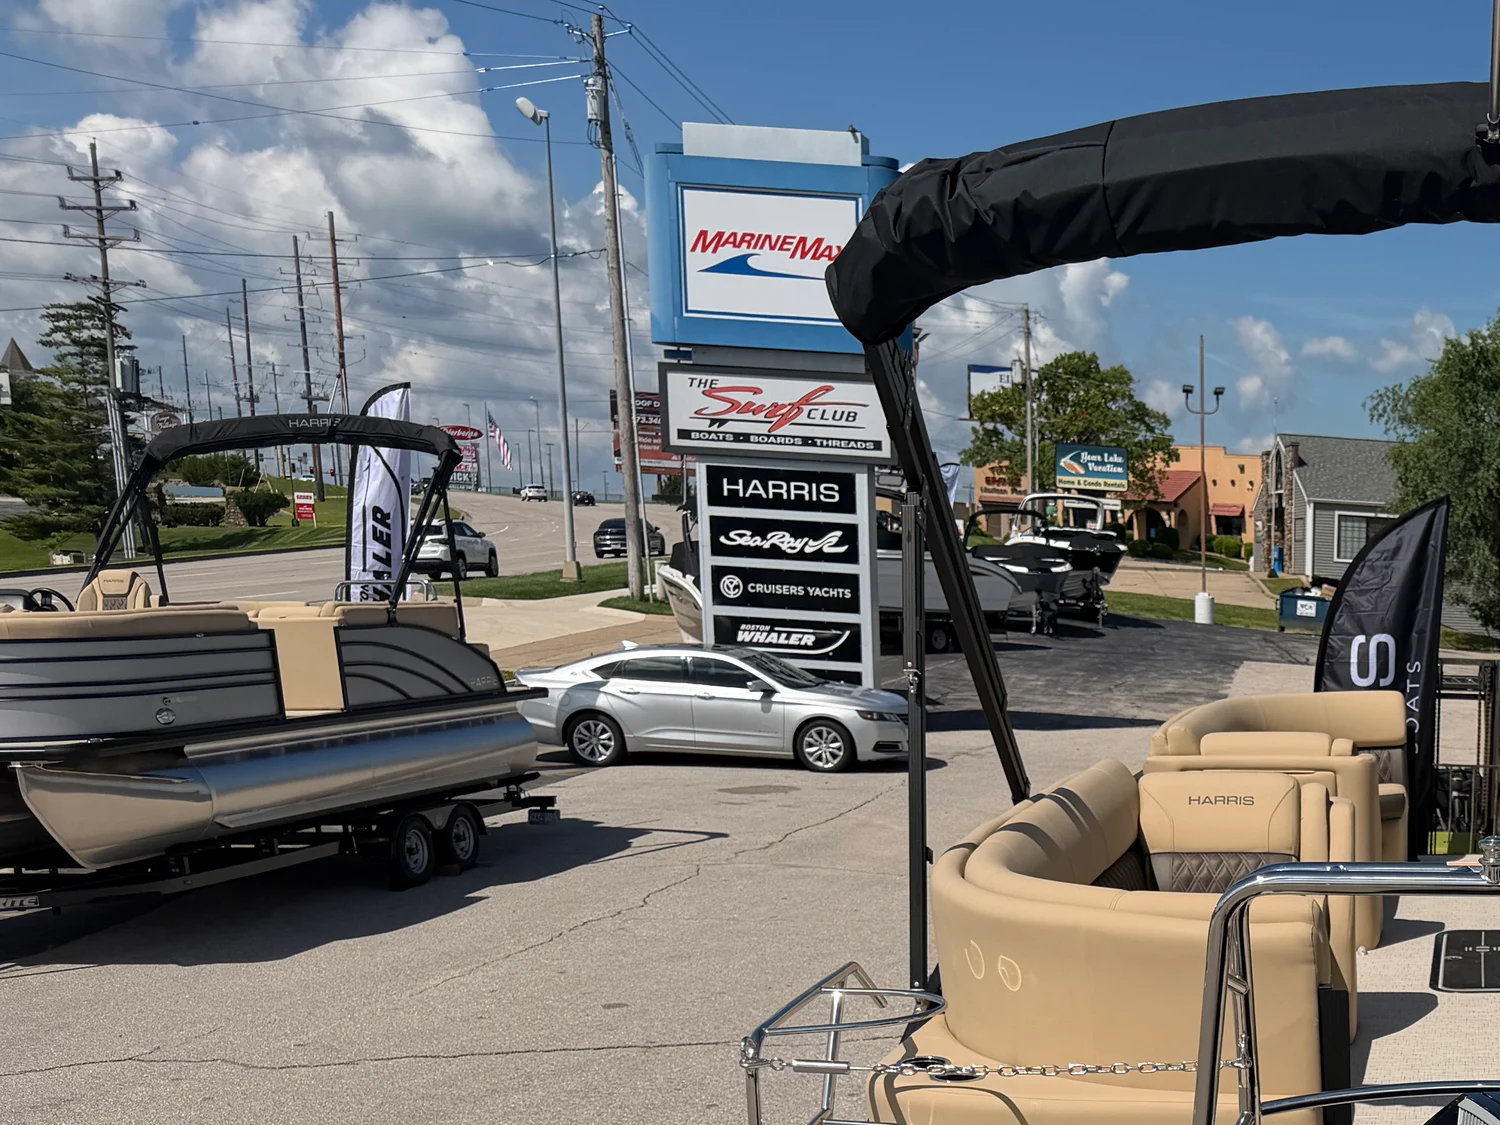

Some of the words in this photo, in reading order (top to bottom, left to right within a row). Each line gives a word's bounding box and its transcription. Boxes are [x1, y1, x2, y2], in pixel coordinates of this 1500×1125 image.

[688, 377, 719, 389] THE
[694, 385, 869, 433] Surf
[807, 408, 858, 422] CLUB
[691, 432, 734, 442] BOATS
[750, 434, 803, 445] BOARDS
[814, 438, 875, 450] THREADS
[1104, 452, 1124, 463] Lake
[1087, 462, 1125, 473] Vacation
[722, 478, 840, 503] HARRIS
[747, 583, 804, 596] CRUISERS
[808, 586, 852, 599] YACHTS
[736, 630, 816, 646] WHALER
[1188, 795, 1255, 806] HARRIS
